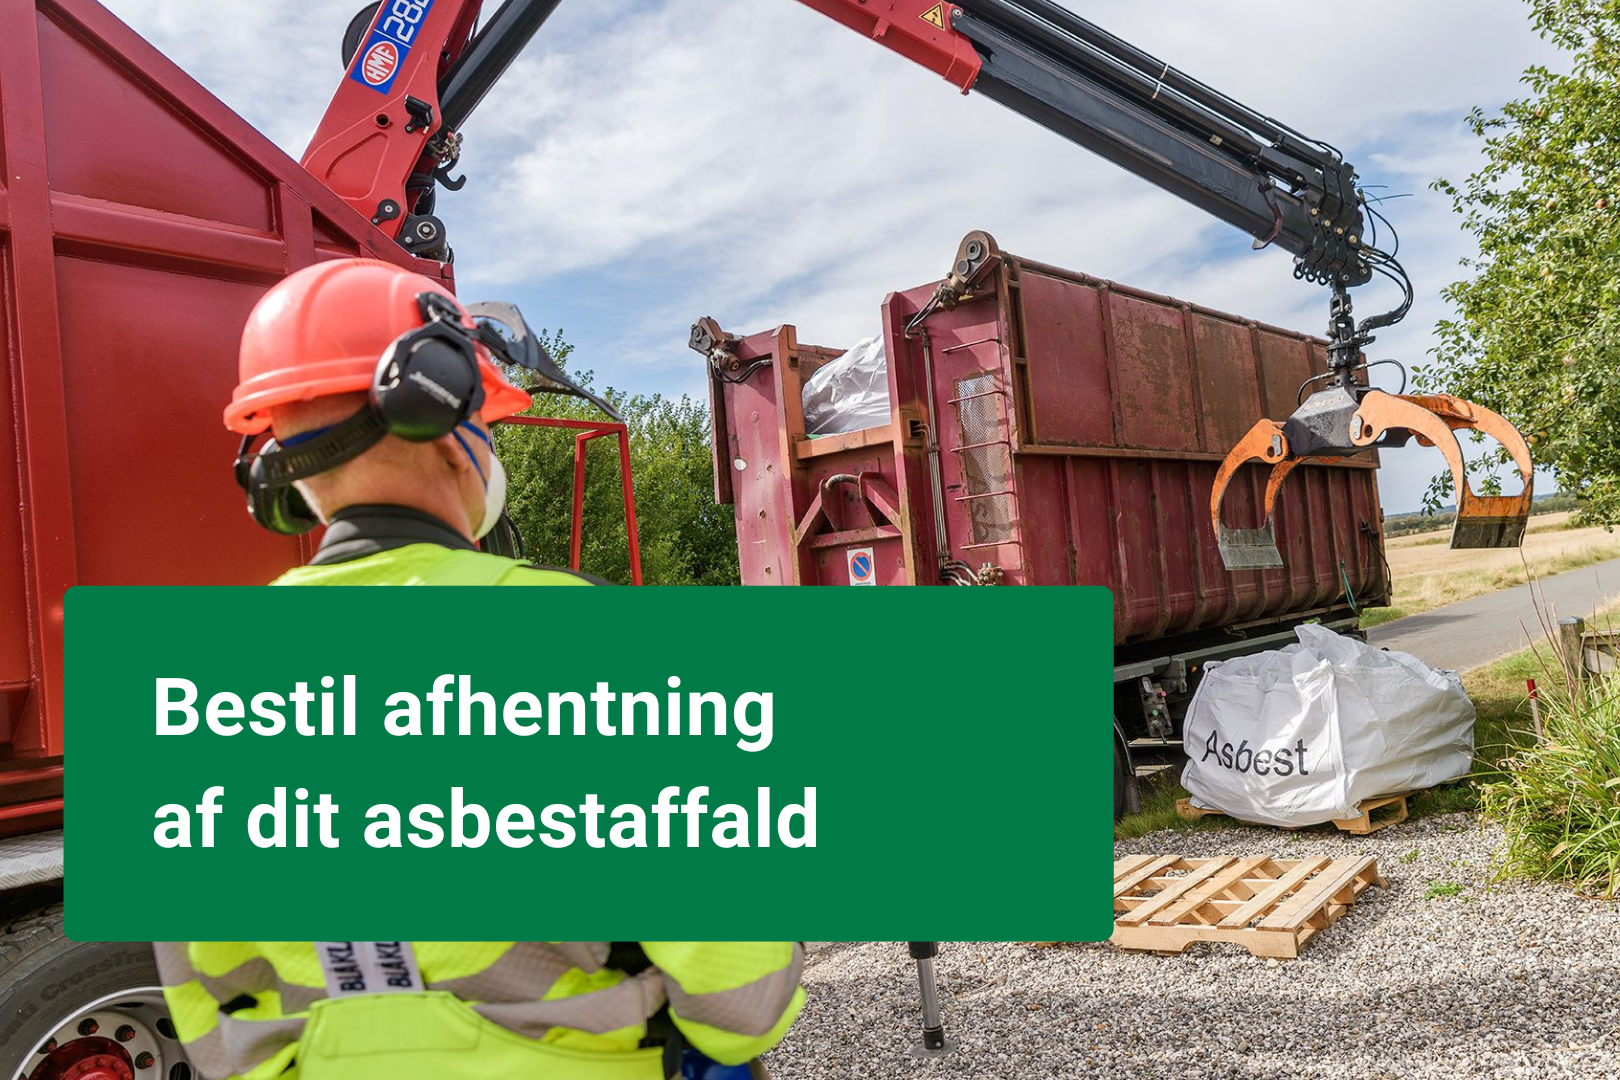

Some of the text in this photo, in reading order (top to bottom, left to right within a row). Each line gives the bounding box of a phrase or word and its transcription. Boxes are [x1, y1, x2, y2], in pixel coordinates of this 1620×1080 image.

[366, 45, 394, 81] HMF
[1201, 729, 1309, 777] Asbest
[0, 1001, 38, 1047] onti
[40, 950, 155, 1001] CrossTra
